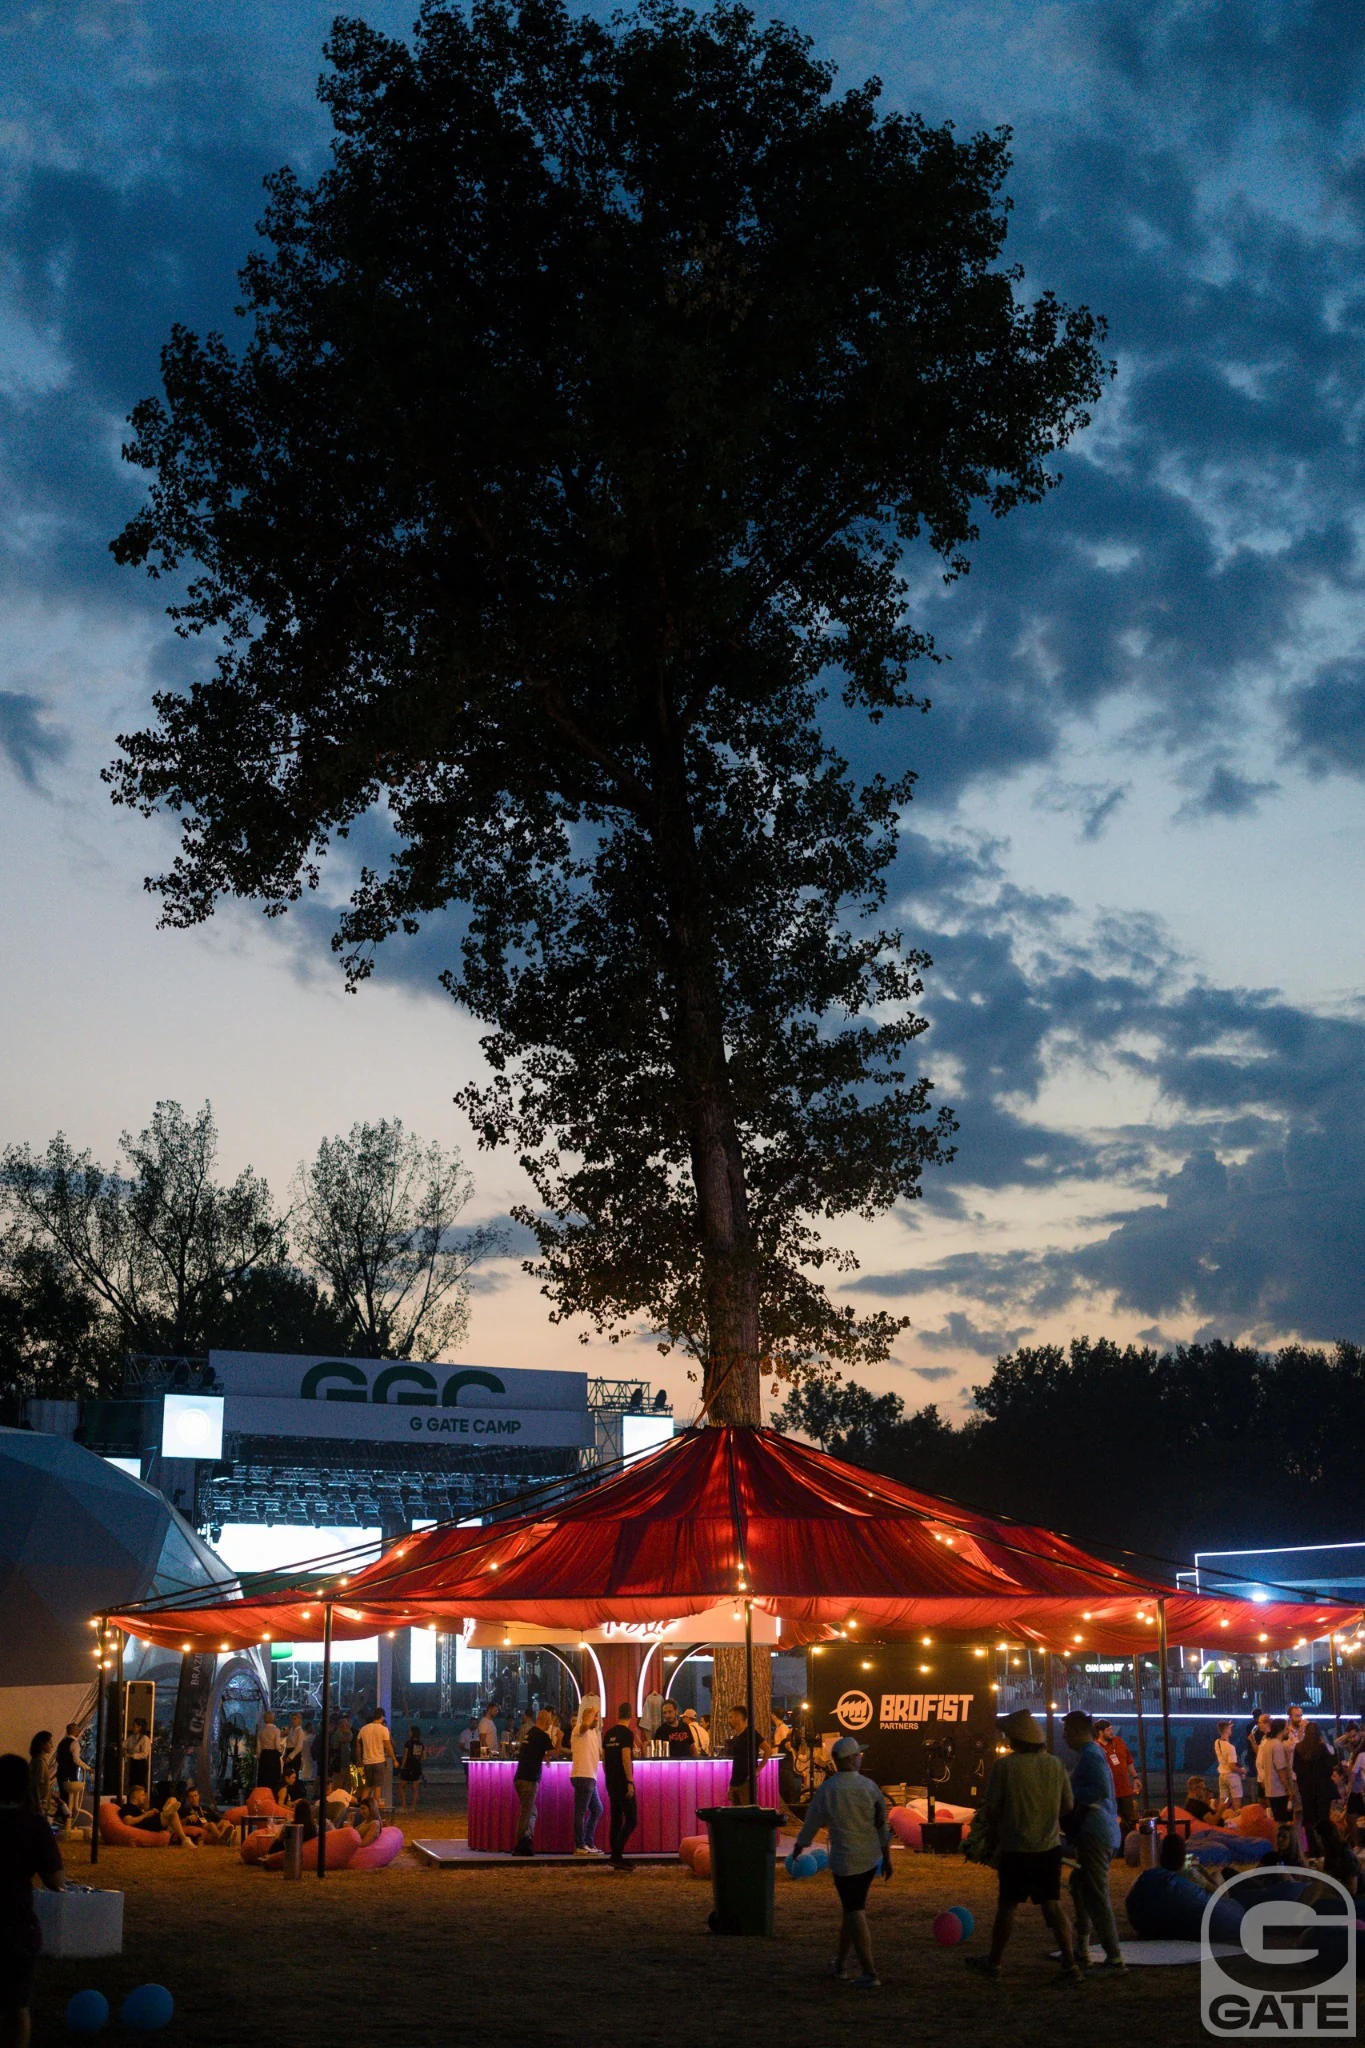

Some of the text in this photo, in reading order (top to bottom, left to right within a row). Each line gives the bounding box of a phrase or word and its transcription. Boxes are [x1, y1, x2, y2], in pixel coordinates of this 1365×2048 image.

[409, 1416, 521, 1434] G GATE CAMP
[880, 1722, 919, 1730] PARTNERS
[1111, 1725, 1193, 1771] BET
